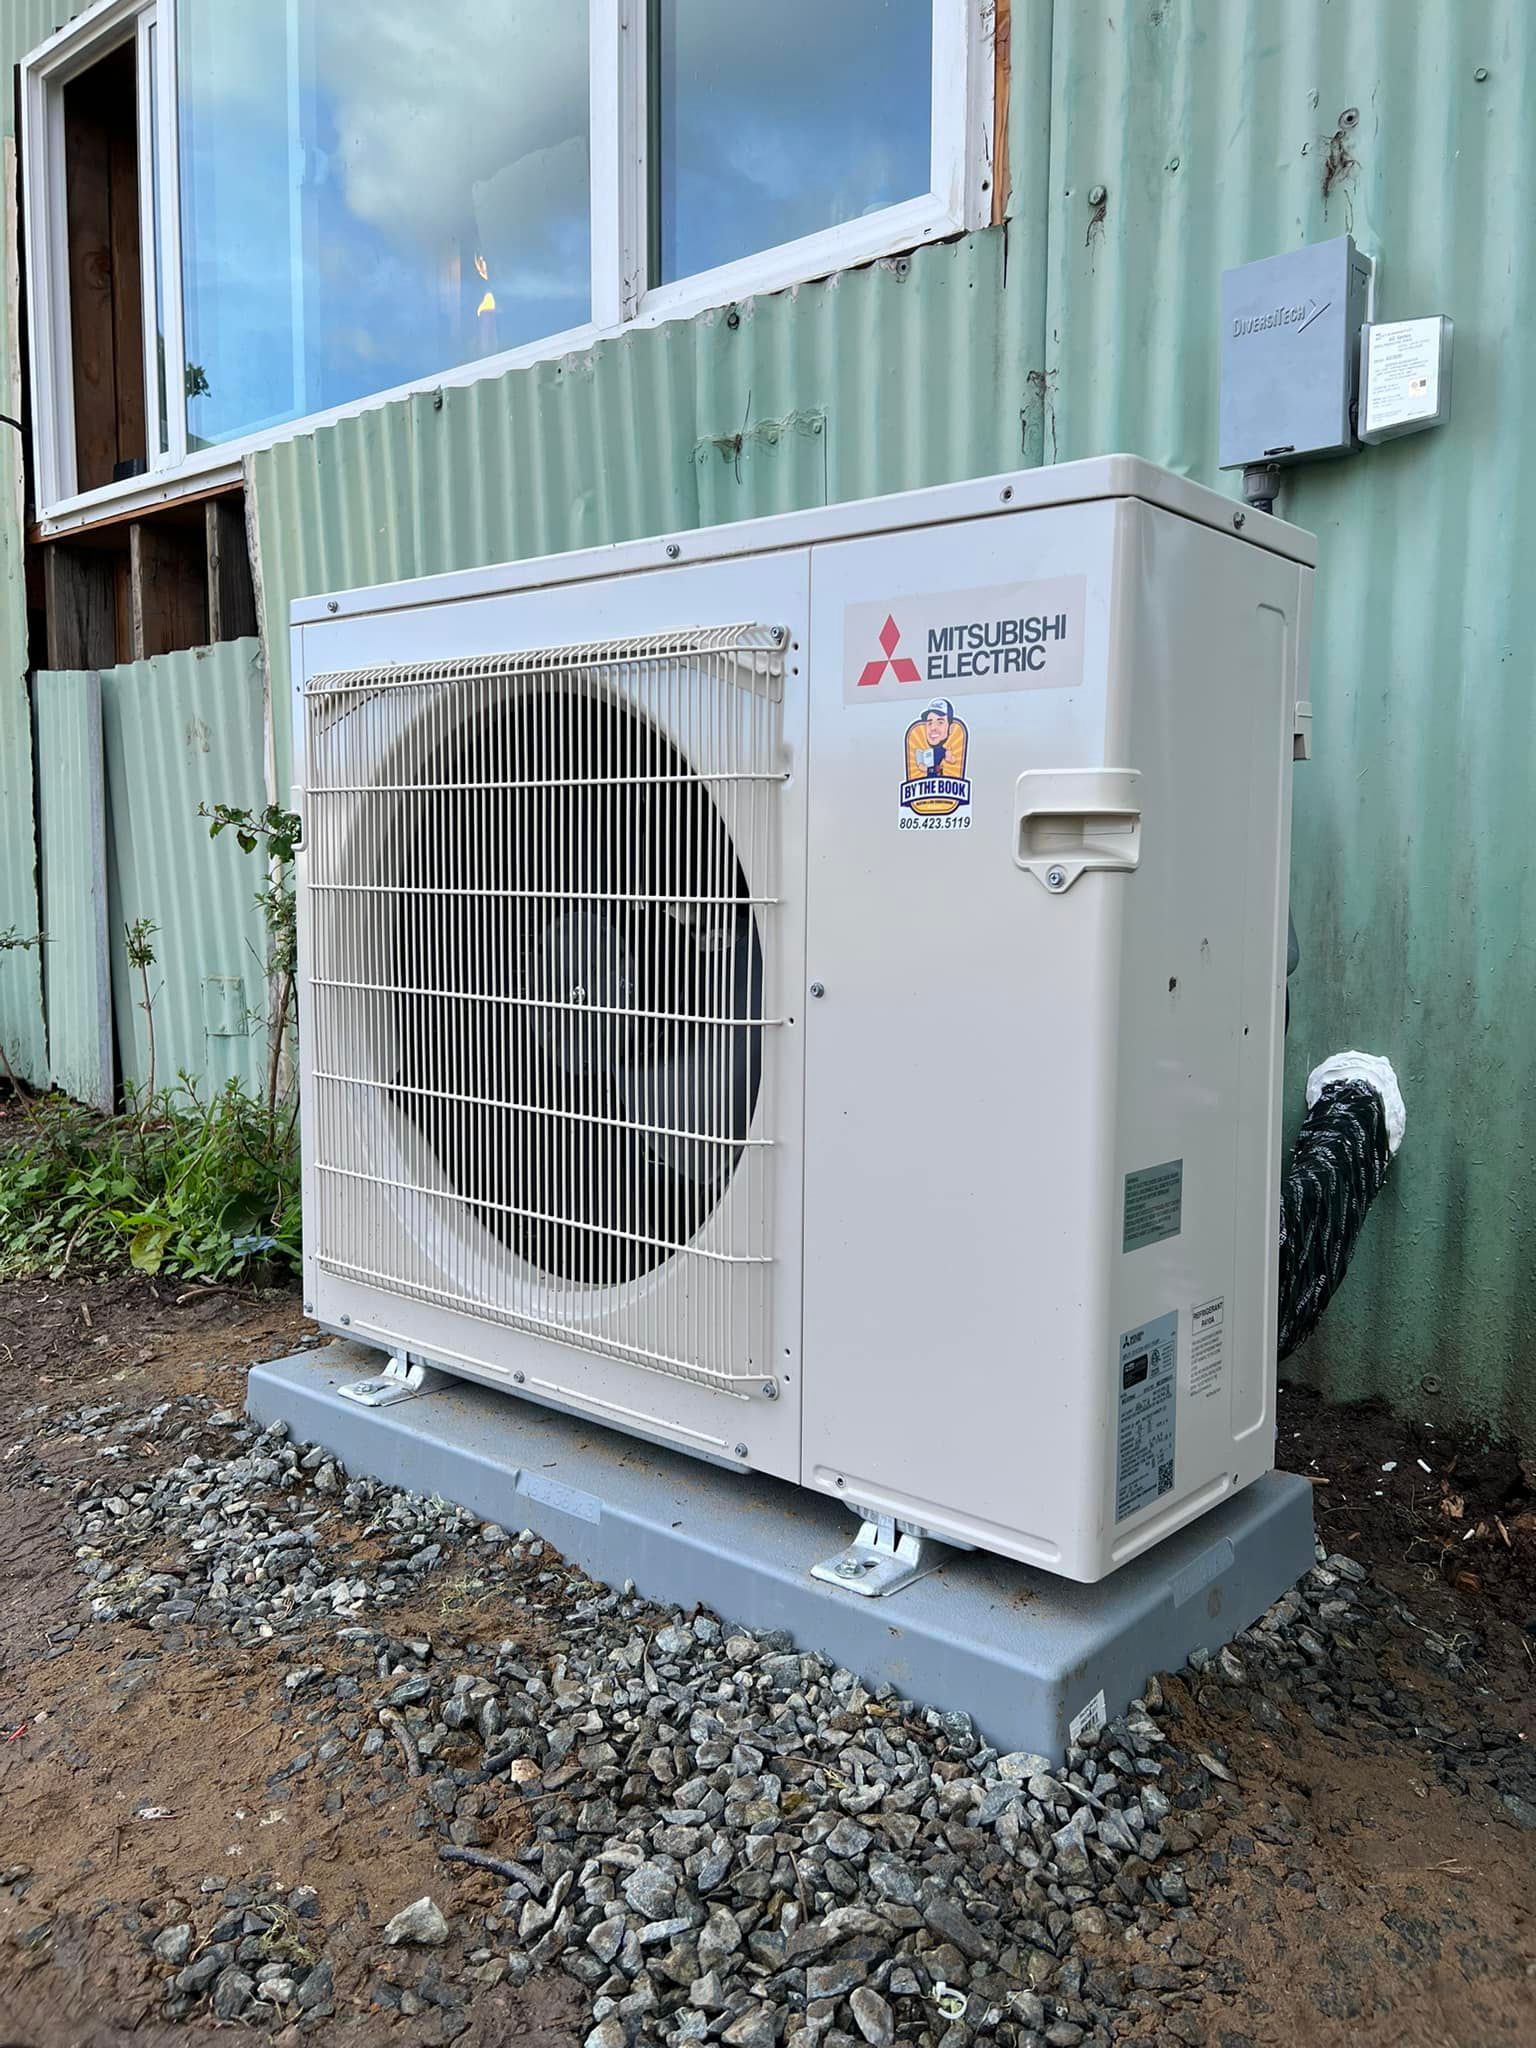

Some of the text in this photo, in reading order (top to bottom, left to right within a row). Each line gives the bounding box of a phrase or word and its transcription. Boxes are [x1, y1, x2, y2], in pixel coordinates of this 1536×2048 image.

[927, 614, 1067, 653] MITSUBISHI
[927, 645, 1046, 680] ELECTRIC
[904, 780, 966, 799] BY THE BOOK
[899, 816, 971, 829] 805.423.5119
